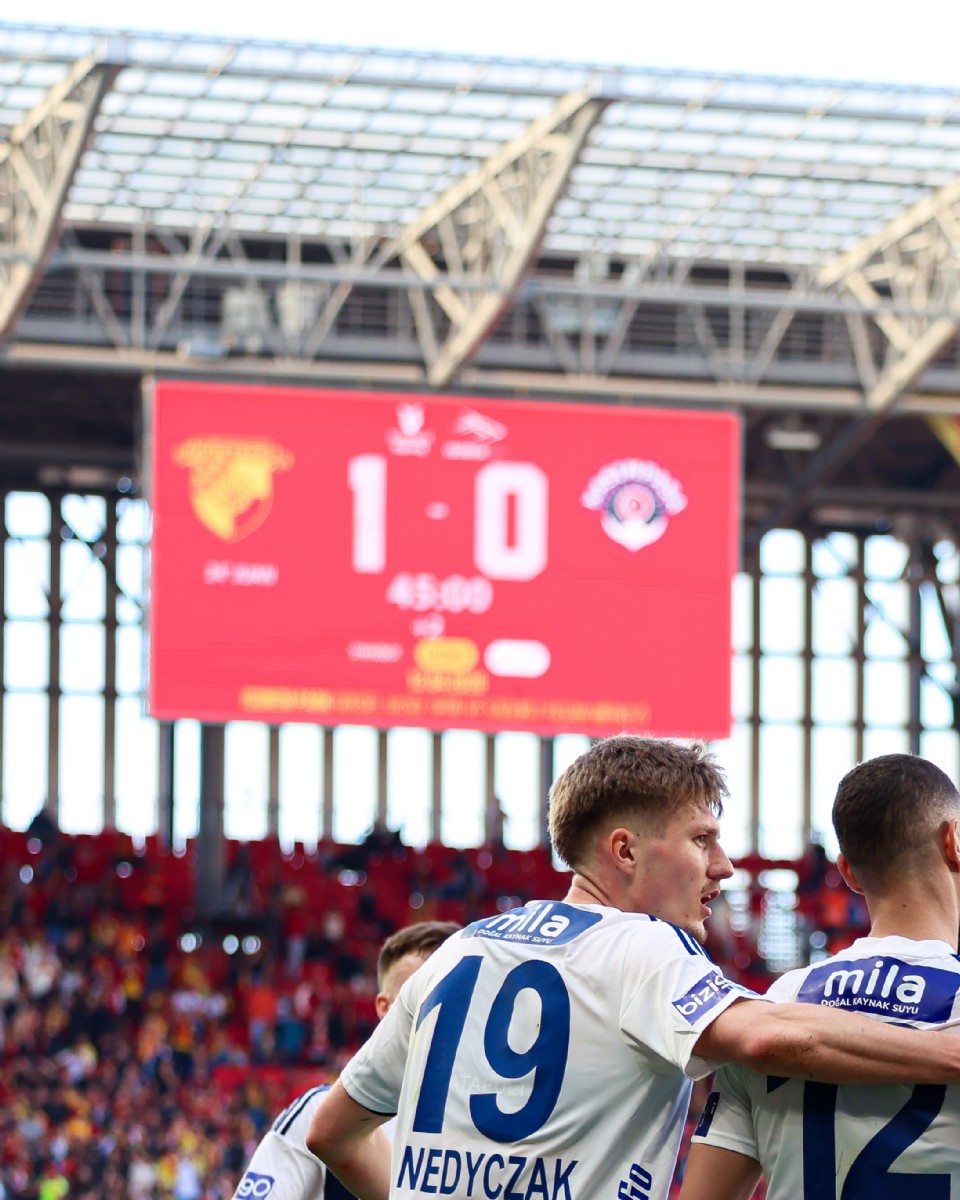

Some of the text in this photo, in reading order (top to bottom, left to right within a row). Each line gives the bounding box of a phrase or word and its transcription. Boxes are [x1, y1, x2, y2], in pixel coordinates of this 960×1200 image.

[347, 453, 388, 574] 1
[473, 460, 549, 582] 0
[485, 903, 570, 938] mila
[531, 936, 553, 944] SUYU
[823, 960, 926, 1005] mila
[892, 1004, 919, 1015] SUYU
[412, 955, 571, 1144] 19
